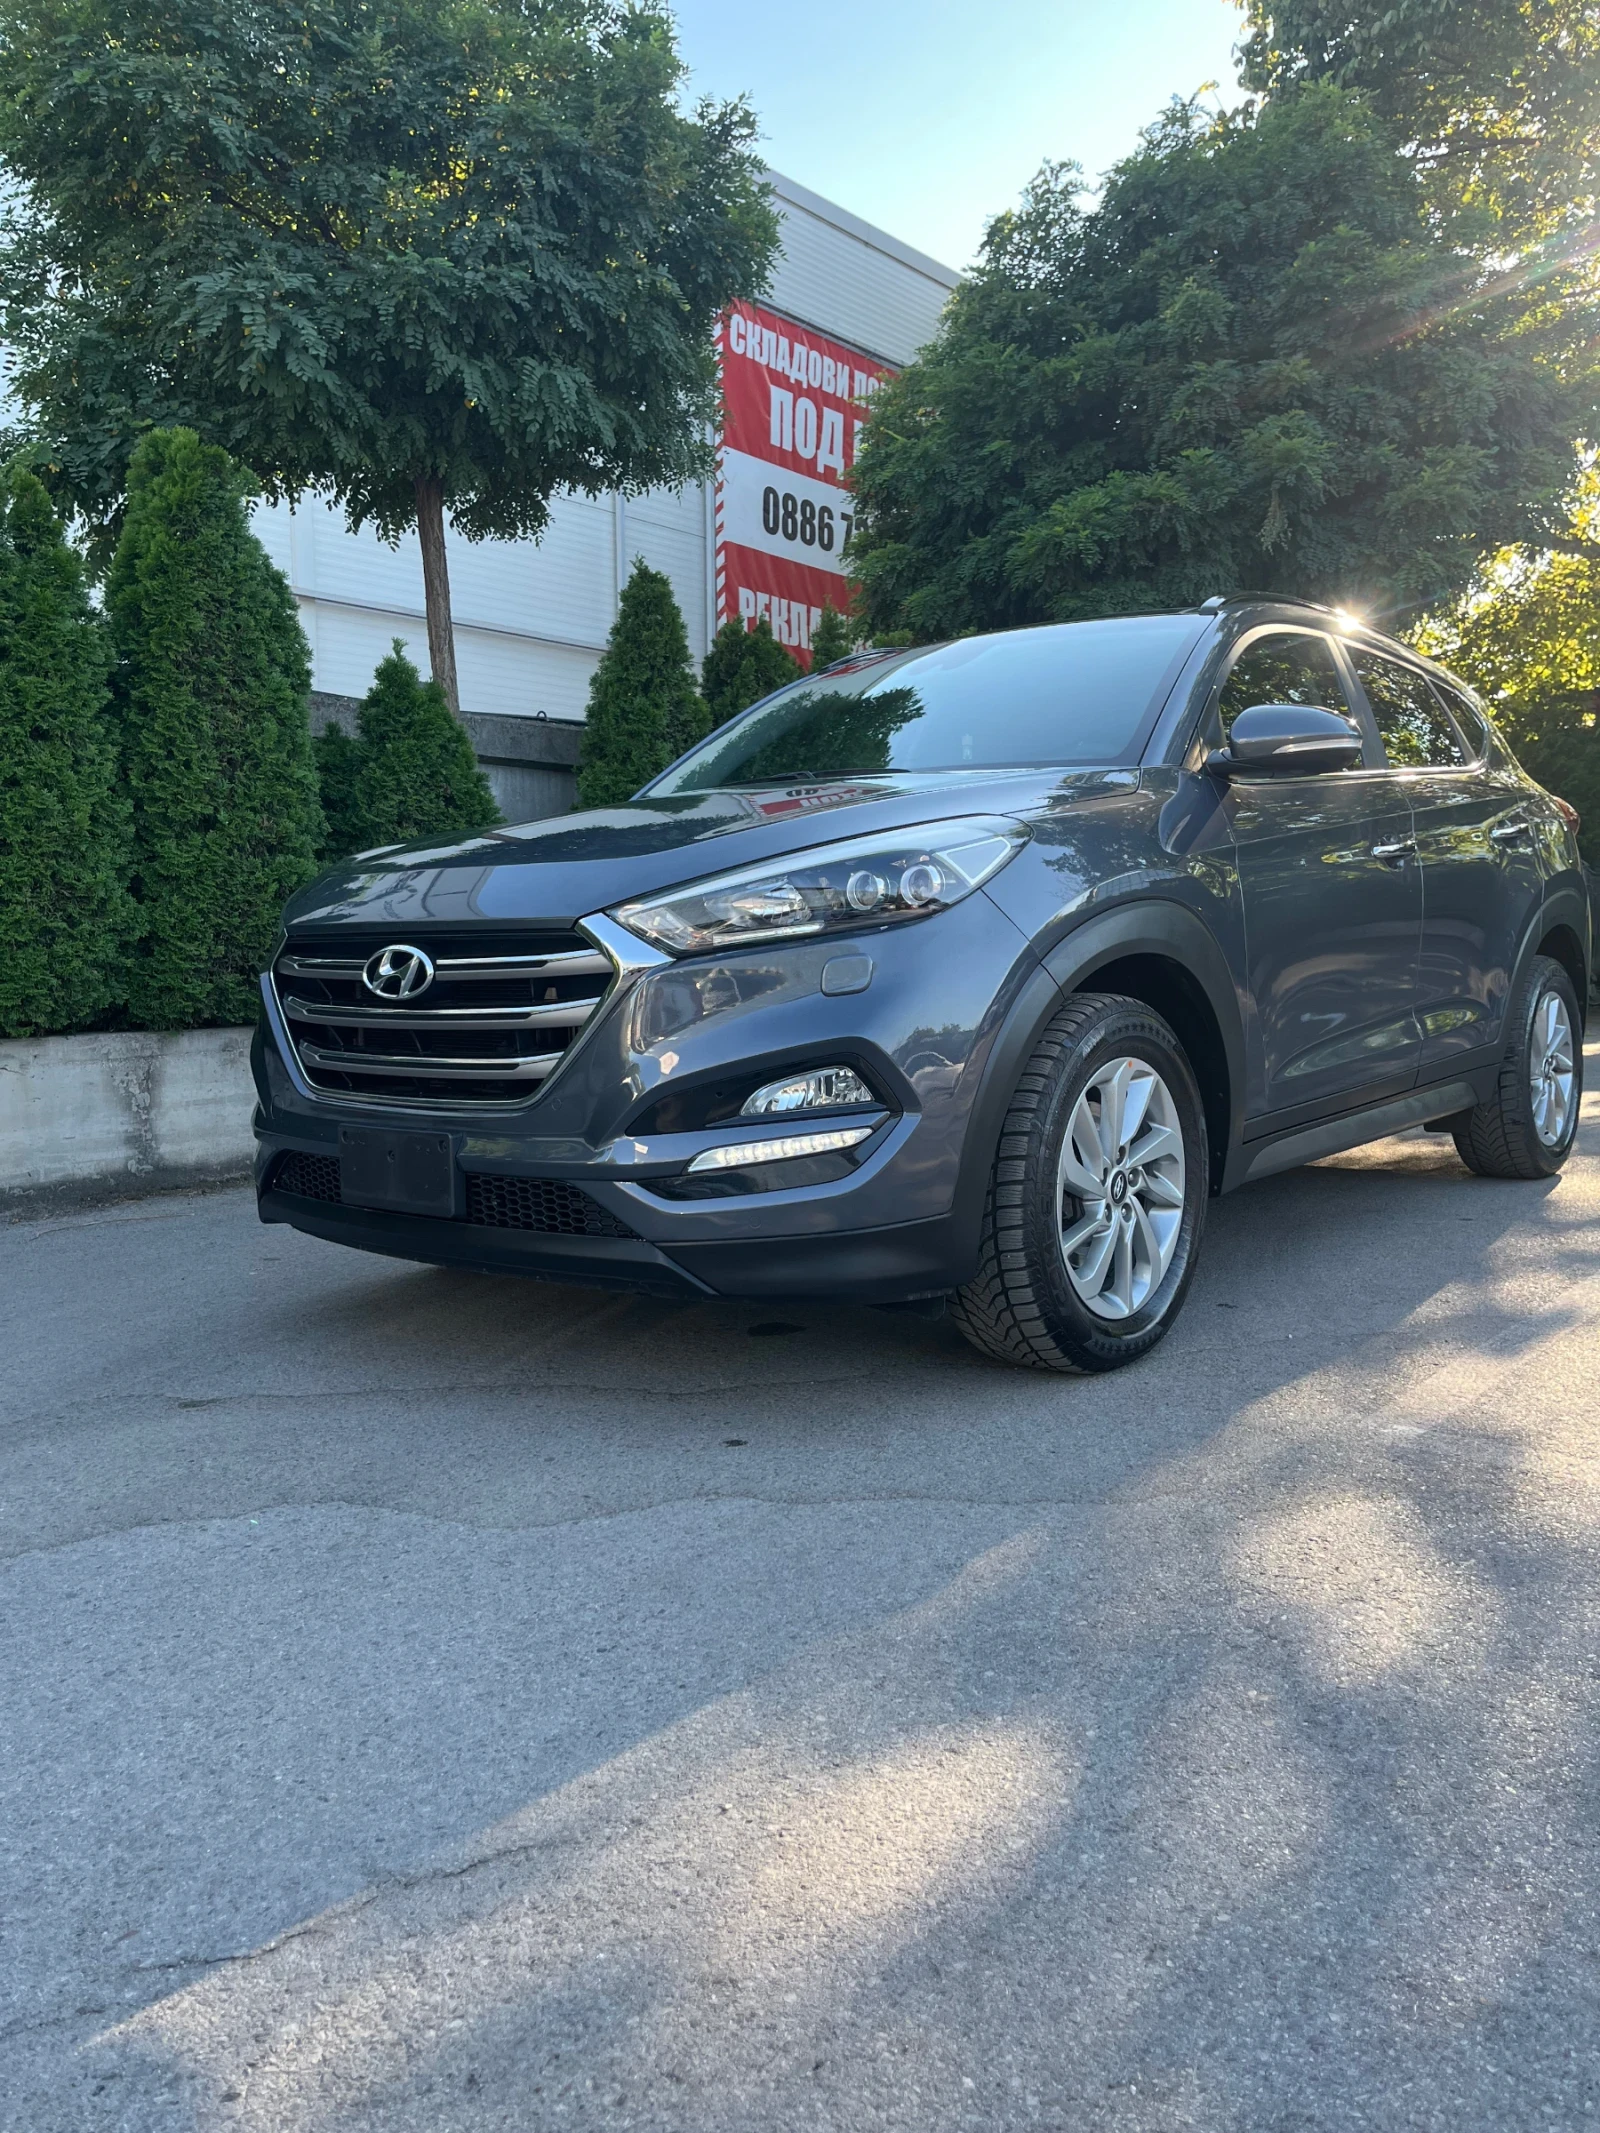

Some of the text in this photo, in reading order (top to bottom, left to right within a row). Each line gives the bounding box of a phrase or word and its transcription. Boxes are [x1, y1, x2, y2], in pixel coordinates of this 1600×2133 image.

[730, 313, 887, 413] СКЛАДОВИ ПО
[770, 384, 845, 480] ПОД
[763, 486, 834, 551] 0886
